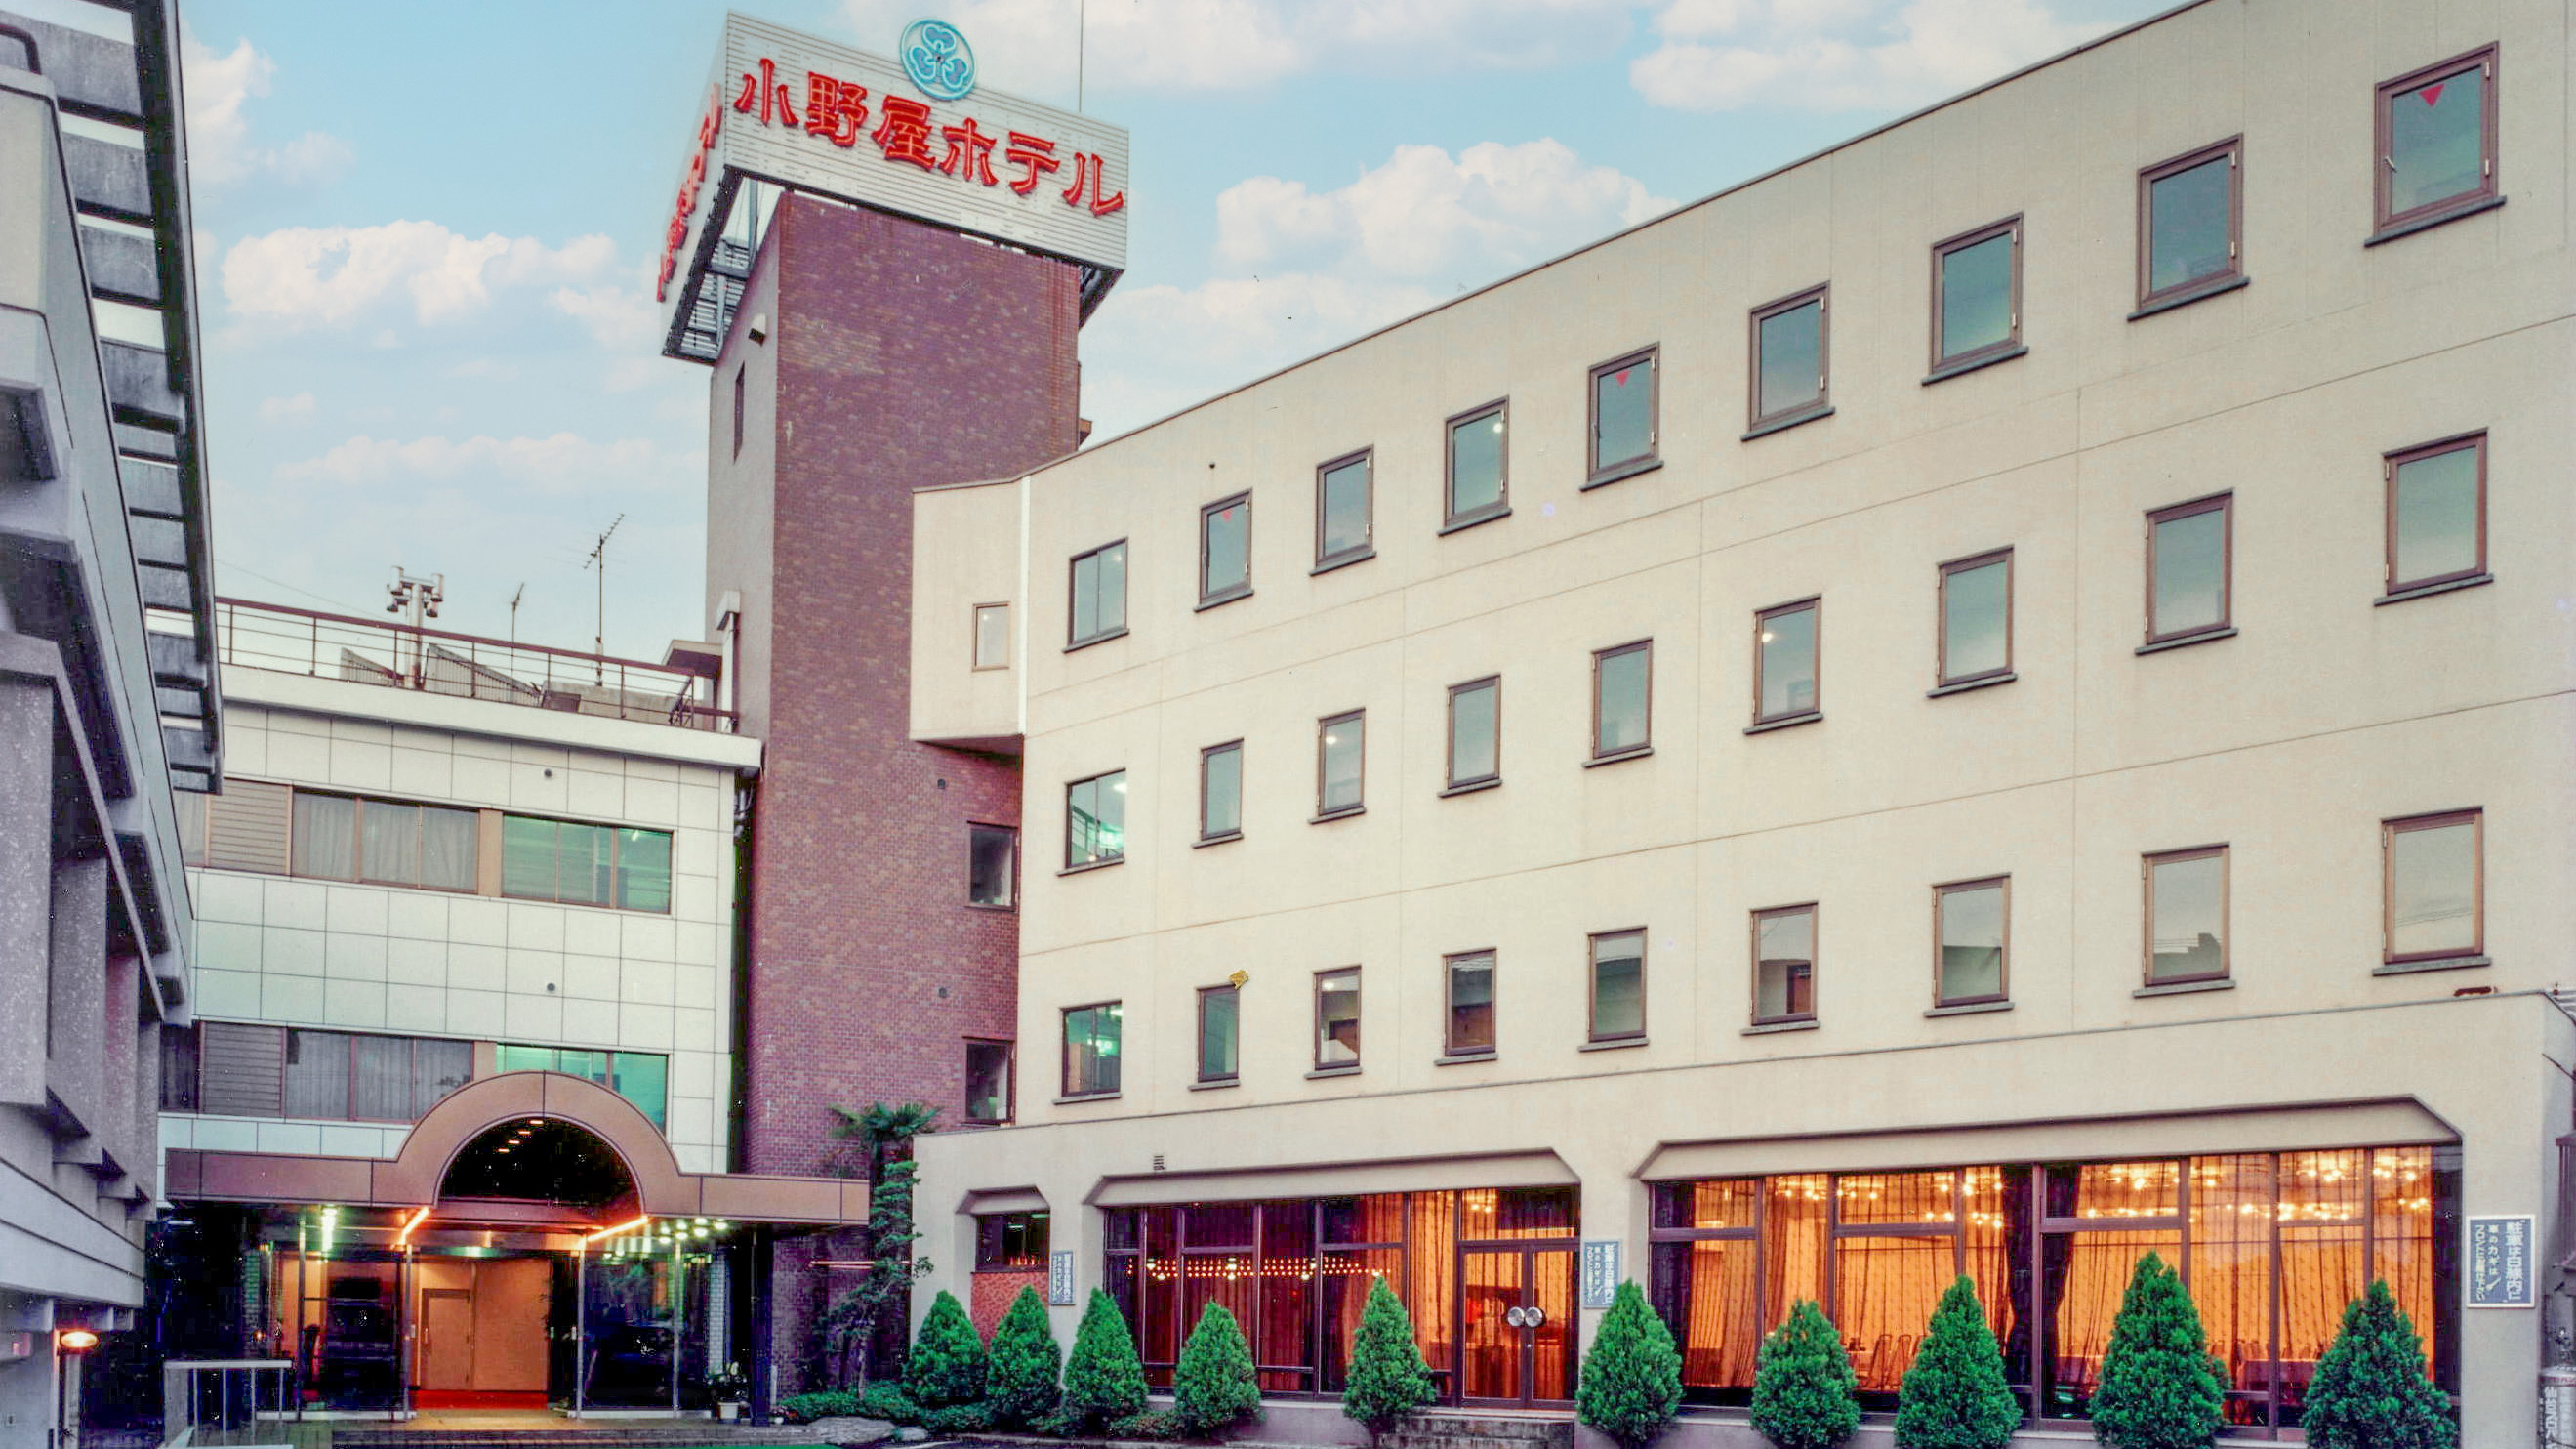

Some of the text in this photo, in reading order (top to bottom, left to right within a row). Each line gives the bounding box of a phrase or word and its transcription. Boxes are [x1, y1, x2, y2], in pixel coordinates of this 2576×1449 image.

[734, 58, 1124, 217] 小野屋ホテル
